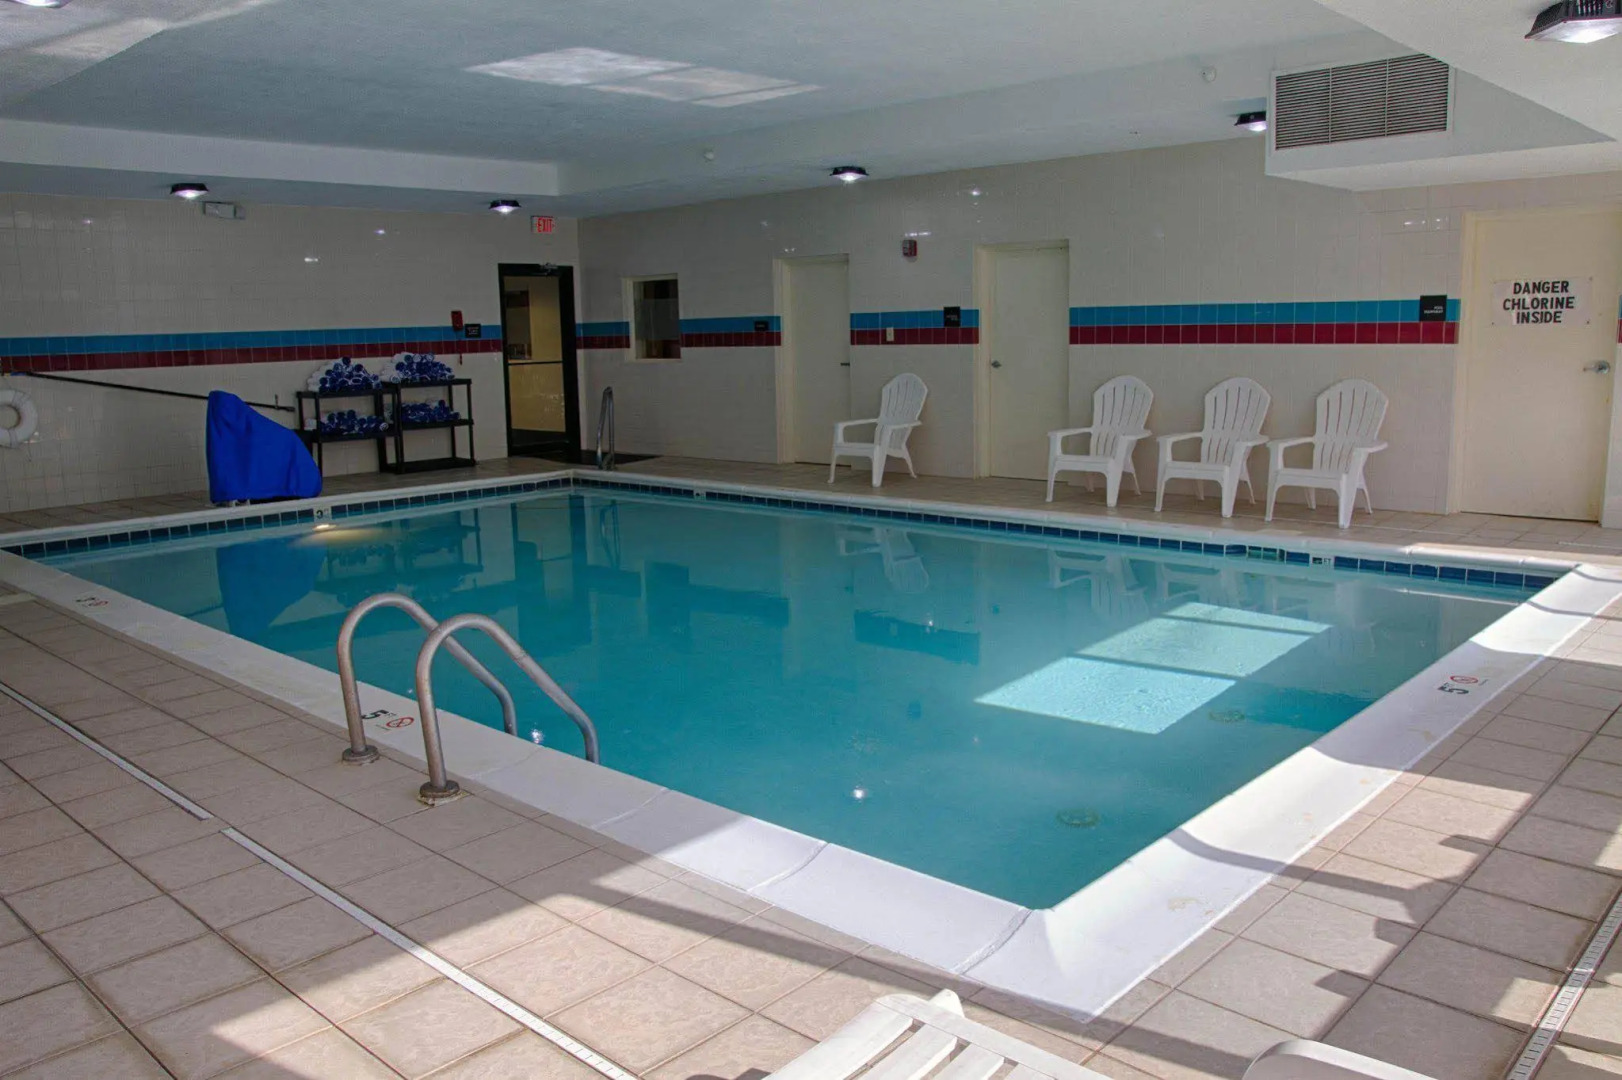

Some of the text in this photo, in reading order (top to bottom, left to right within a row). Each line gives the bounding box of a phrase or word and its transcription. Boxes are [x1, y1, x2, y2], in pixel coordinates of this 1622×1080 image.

[537, 217, 553, 233] EXIT
[1513, 281, 1569, 294] DANGER
[1503, 297, 1575, 310] CHLORINE
[1516, 311, 1562, 324] INSIDE
[1437, 684, 1469, 694] 5
[361, 709, 389, 719] 5
